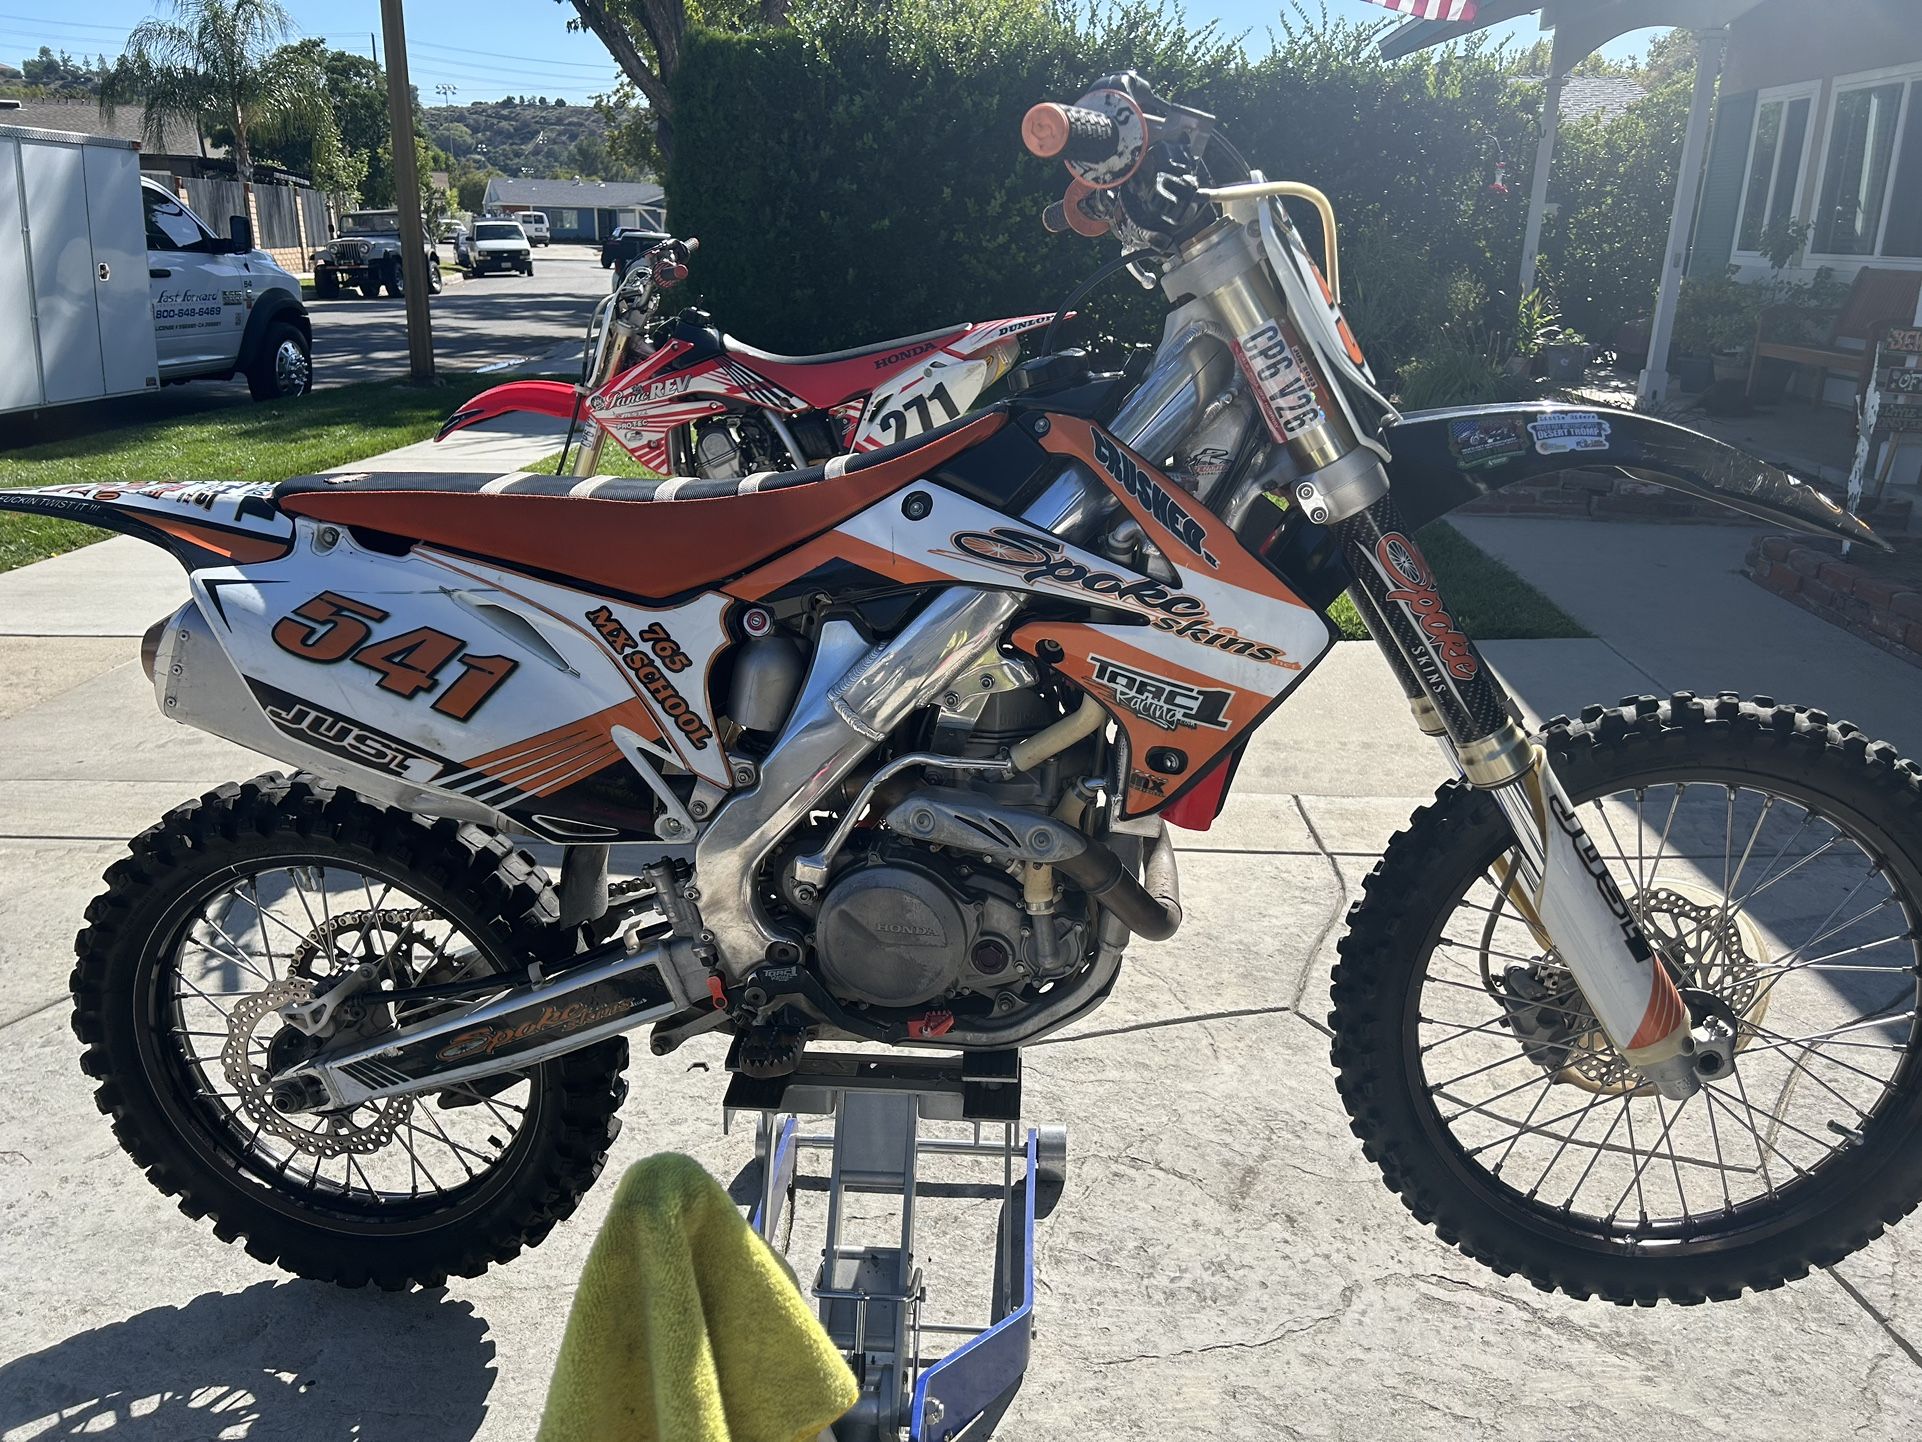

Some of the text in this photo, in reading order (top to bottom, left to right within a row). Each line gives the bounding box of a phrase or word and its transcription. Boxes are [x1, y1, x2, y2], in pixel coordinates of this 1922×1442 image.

[874, 342, 938, 370] HONDA
[1243, 326, 1319, 433] CP6 V26
[880, 381, 961, 444] 271
[1537, 428, 1569, 440] DESERT
[40, 497, 72, 510] TWIST
[74, 502, 88, 512] IT
[271, 590, 520, 724] 541
[639, 622, 693, 673] 765
[1411, 645, 1447, 693] SKINS
[585, 605, 713, 750] MX SCHOOL
[875, 922, 940, 937] HONDA
